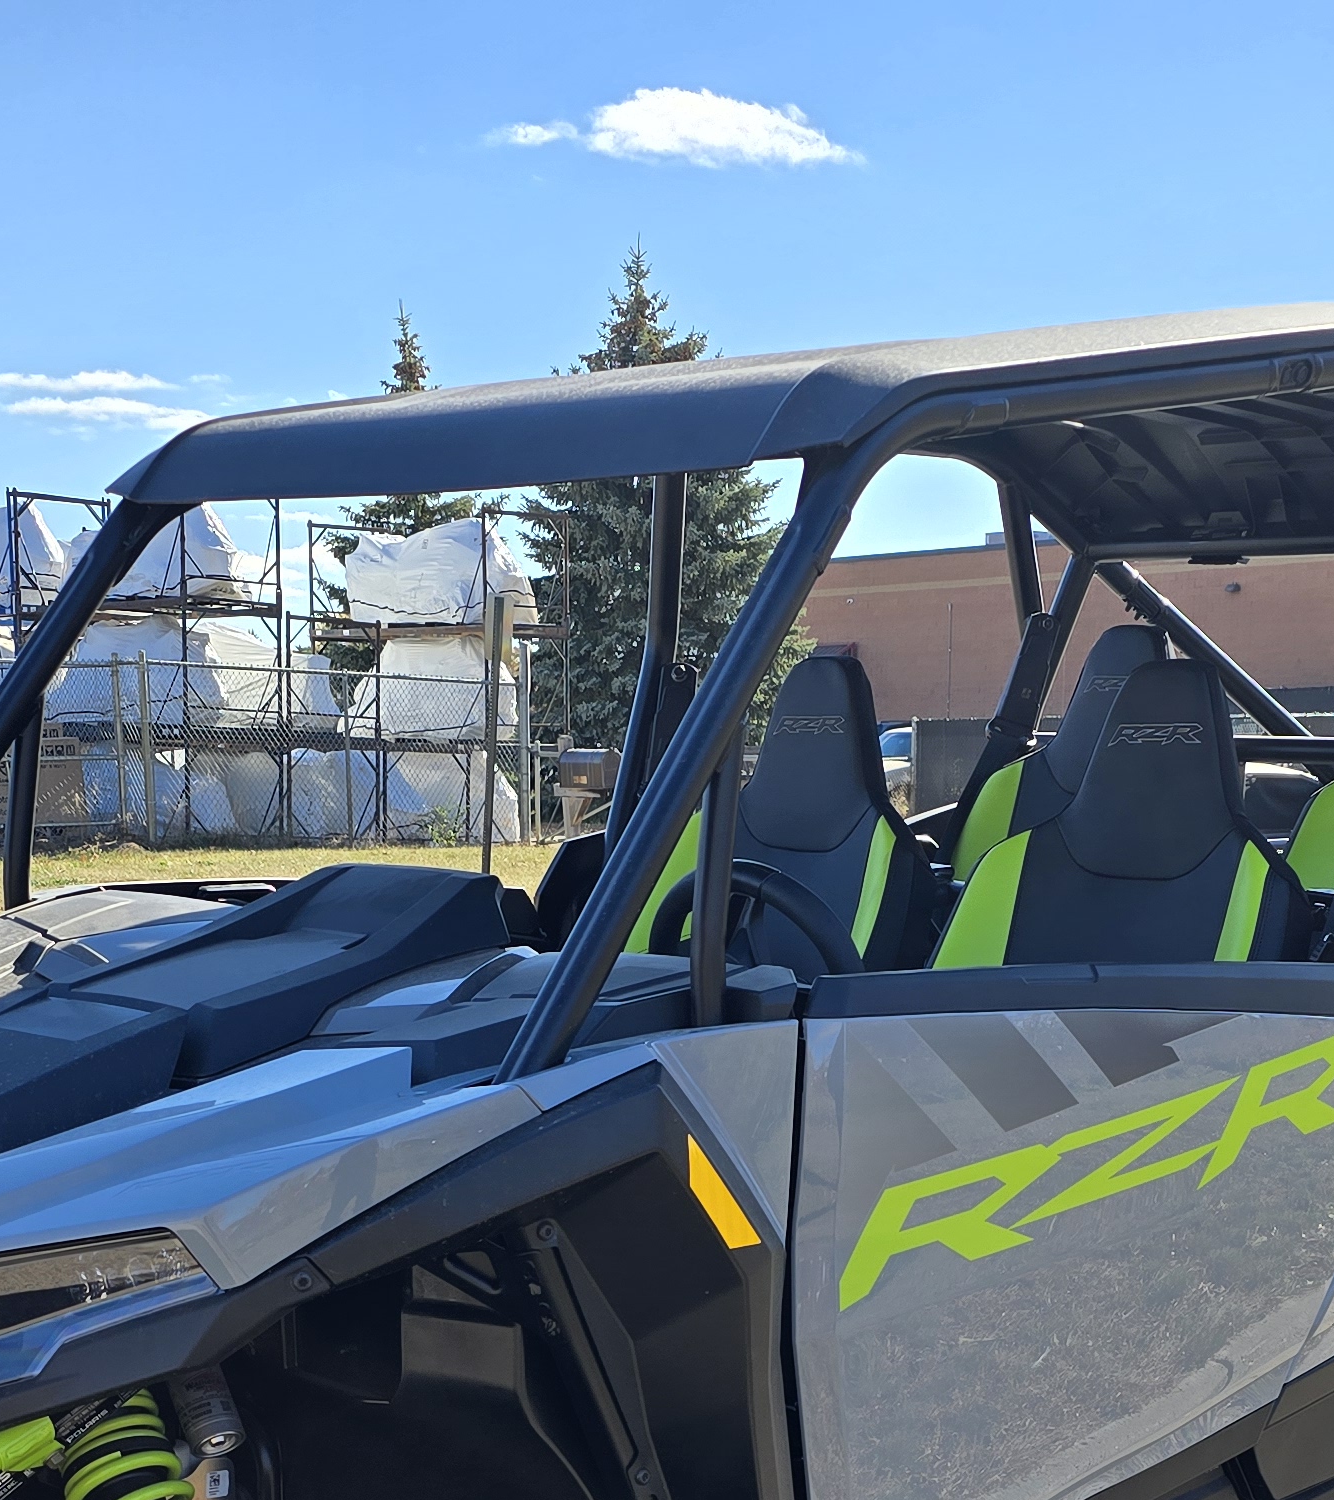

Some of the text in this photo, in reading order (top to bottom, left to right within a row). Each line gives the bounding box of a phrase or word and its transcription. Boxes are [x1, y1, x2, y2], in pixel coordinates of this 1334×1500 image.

[772, 715, 845, 735] RZR
[1108, 723, 1203, 747] RZR
[66, 1409, 108, 1443] POLARIS
